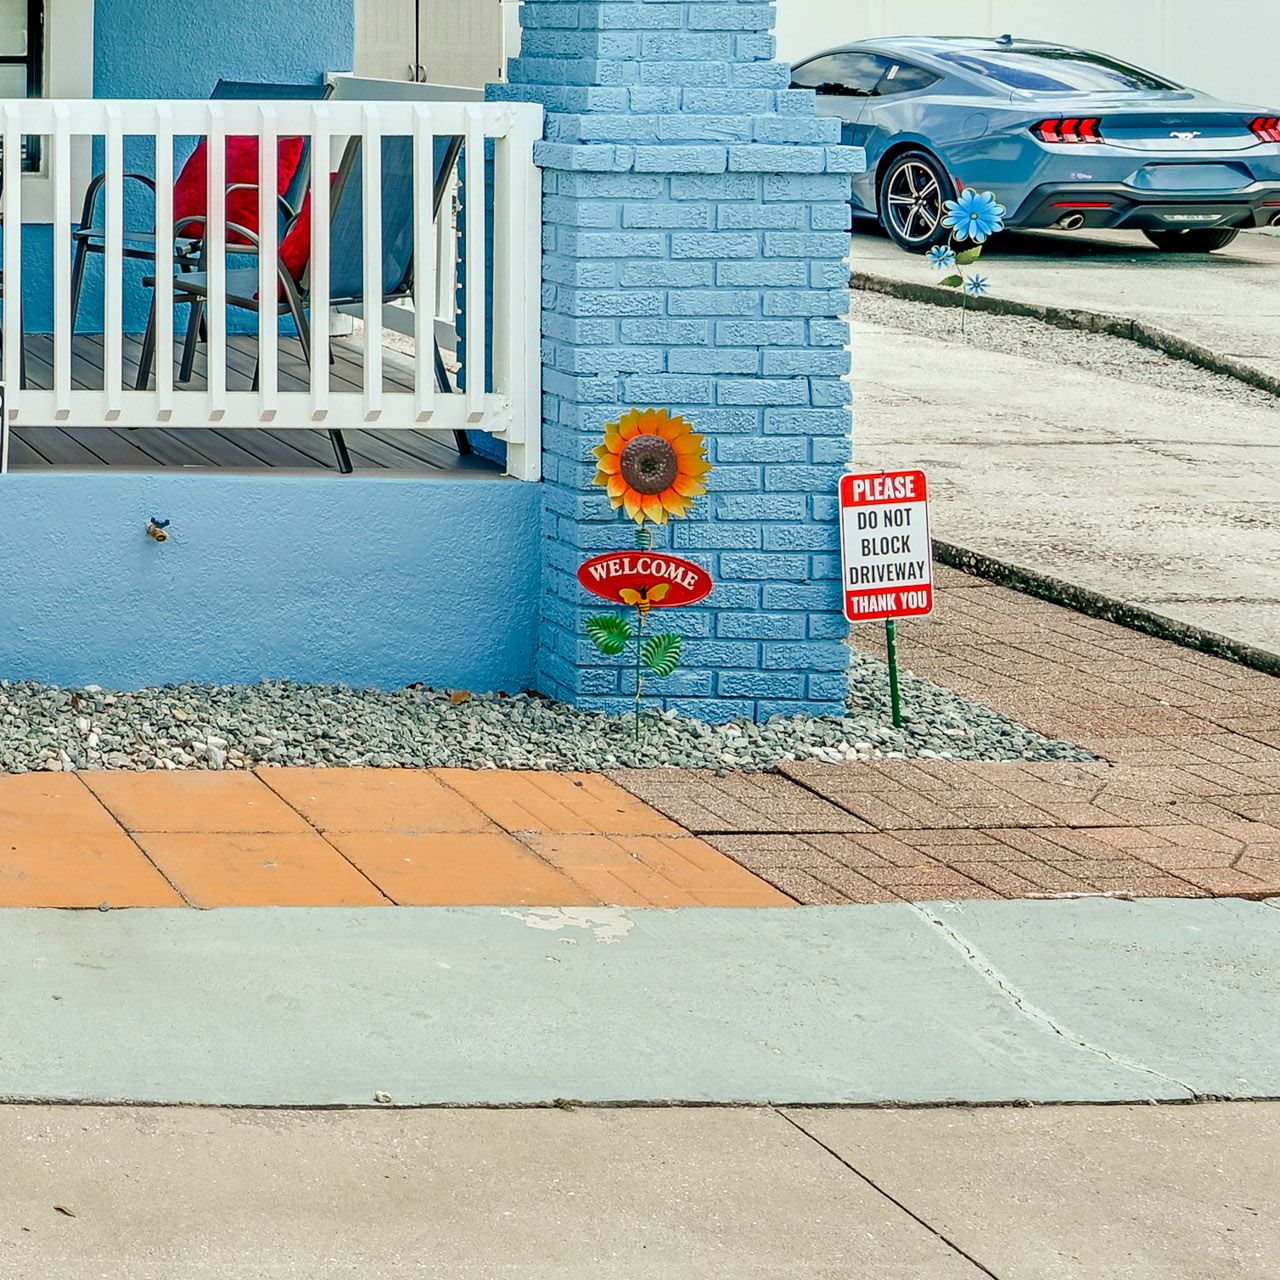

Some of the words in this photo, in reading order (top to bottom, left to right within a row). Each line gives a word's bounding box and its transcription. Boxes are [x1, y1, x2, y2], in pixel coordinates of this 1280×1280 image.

[852, 475, 915, 502] PLEASE
[857, 510, 878, 530] DO
[883, 508, 912, 528] NOT
[861, 535, 911, 557] BLOCK
[588, 557, 699, 591] WELCOME
[849, 561, 925, 585] DRIVEWAY
[851, 593, 897, 614] THANK
[899, 590, 928, 609] YOU
